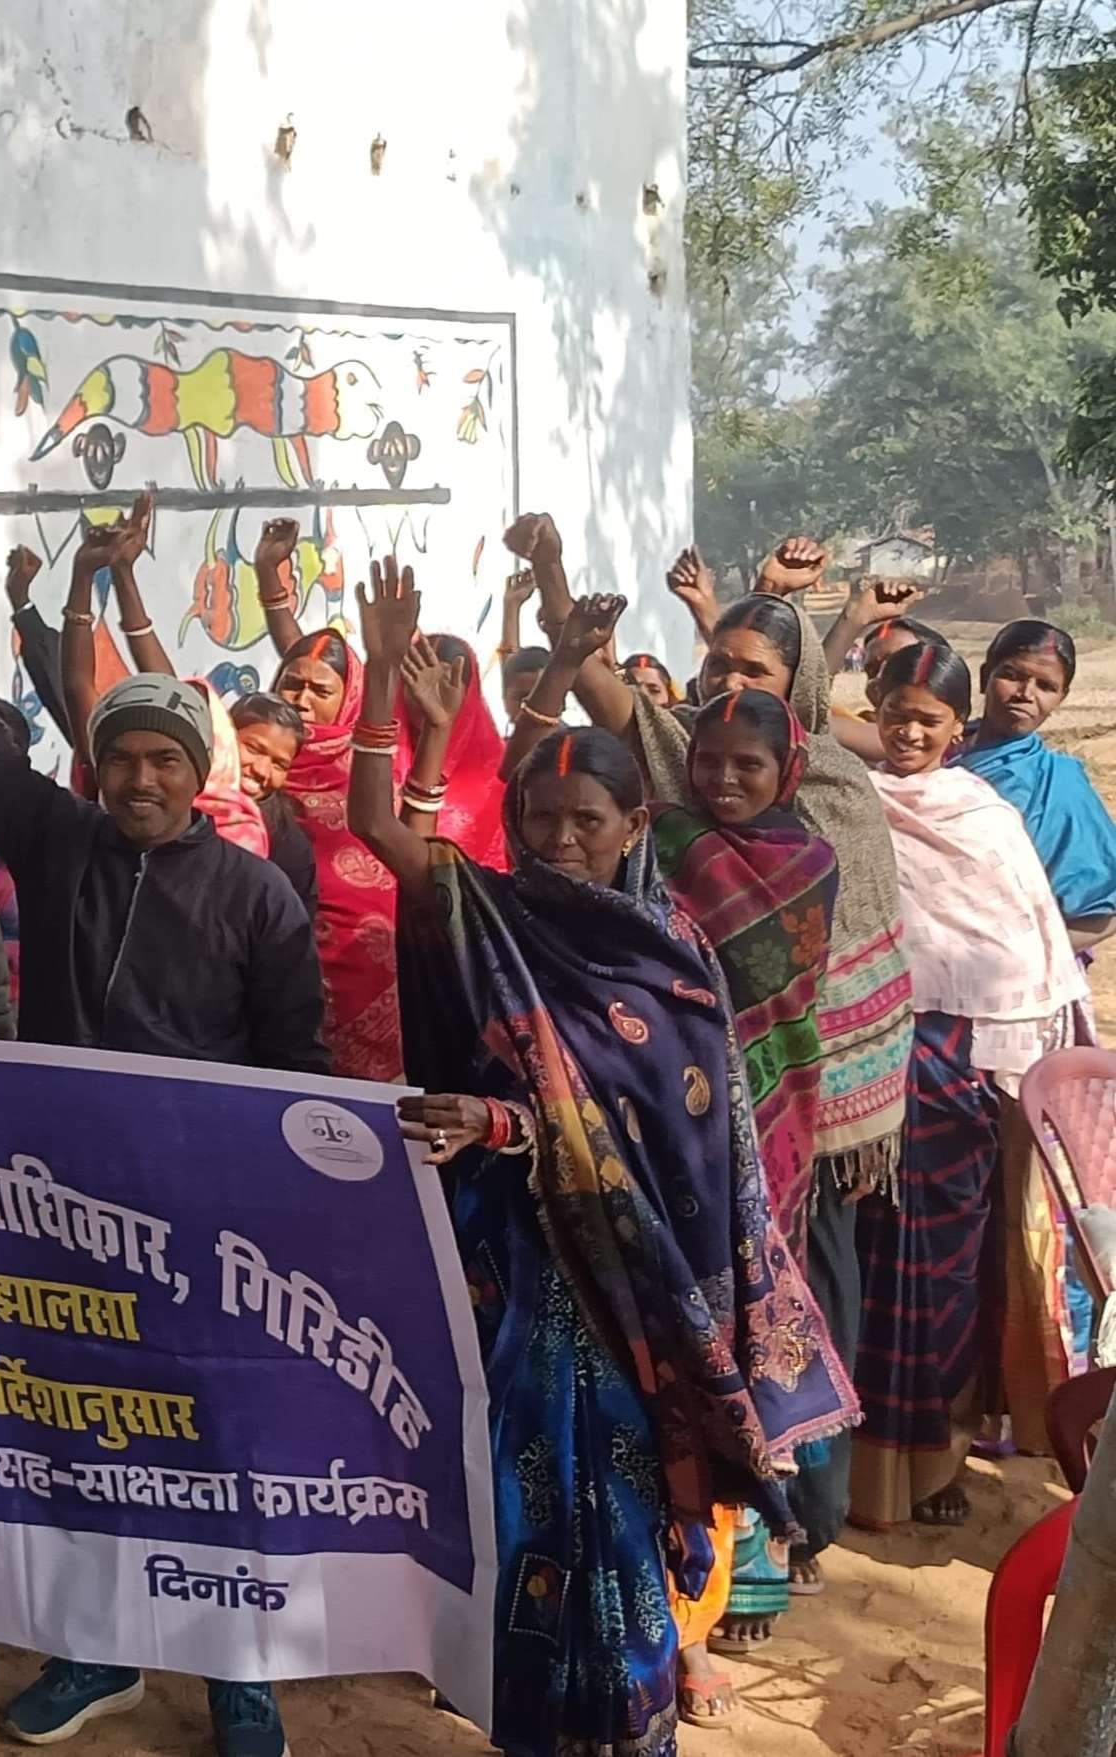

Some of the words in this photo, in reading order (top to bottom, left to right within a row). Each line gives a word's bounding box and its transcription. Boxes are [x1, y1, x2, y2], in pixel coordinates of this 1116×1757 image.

[214, 1230, 432, 1450] गिरिडीह
[247, 1458, 429, 1529] कार्यक्रम
[143, 1554, 288, 1613] दिनांक
